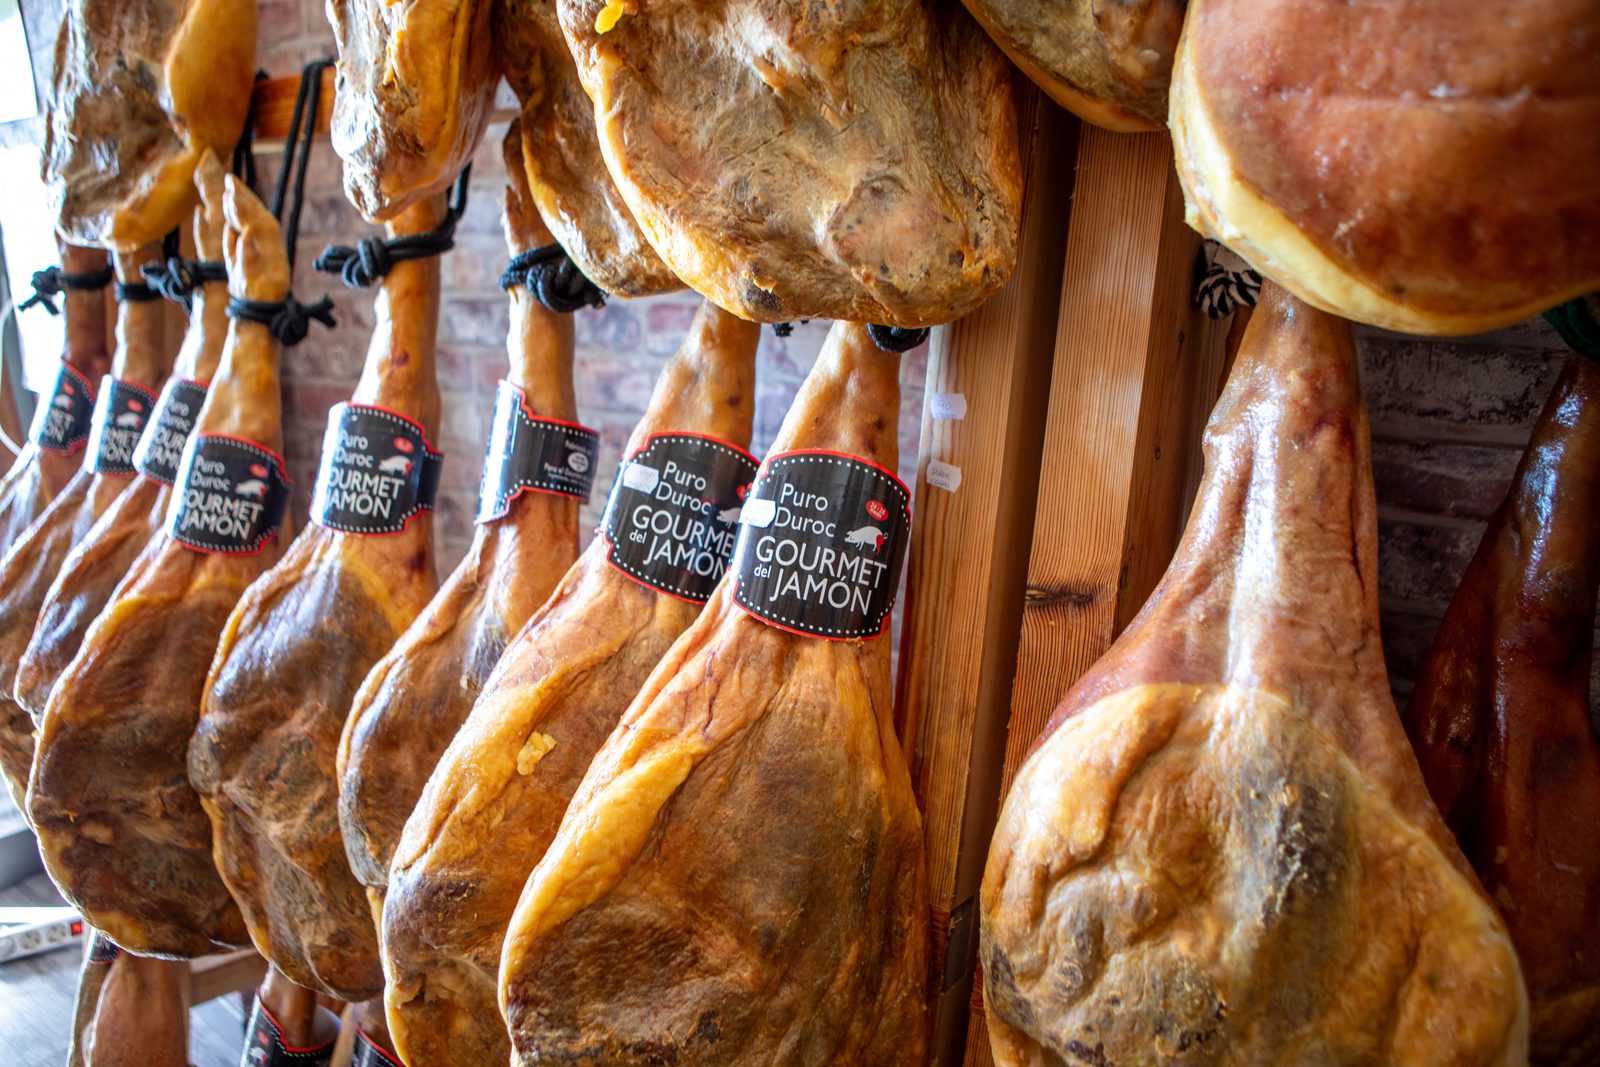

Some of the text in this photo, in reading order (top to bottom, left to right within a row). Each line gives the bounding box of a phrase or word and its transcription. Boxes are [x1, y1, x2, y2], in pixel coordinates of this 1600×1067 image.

[190, 468, 231, 492] Duroc
[193, 454, 226, 476] Puro
[662, 460, 708, 491] Puro
[328, 465, 406, 500] OURMET
[779, 482, 829, 512] Puro
[183, 488, 264, 523] OURMET
[655, 482, 714, 516] Duroc
[629, 530, 647, 544] del
[632, 504, 736, 557] GOURME
[774, 507, 837, 539] Duroc
[753, 563, 772, 579] del
[755, 535, 888, 589] GOURMET
[770, 568, 873, 617] JAMÓN
